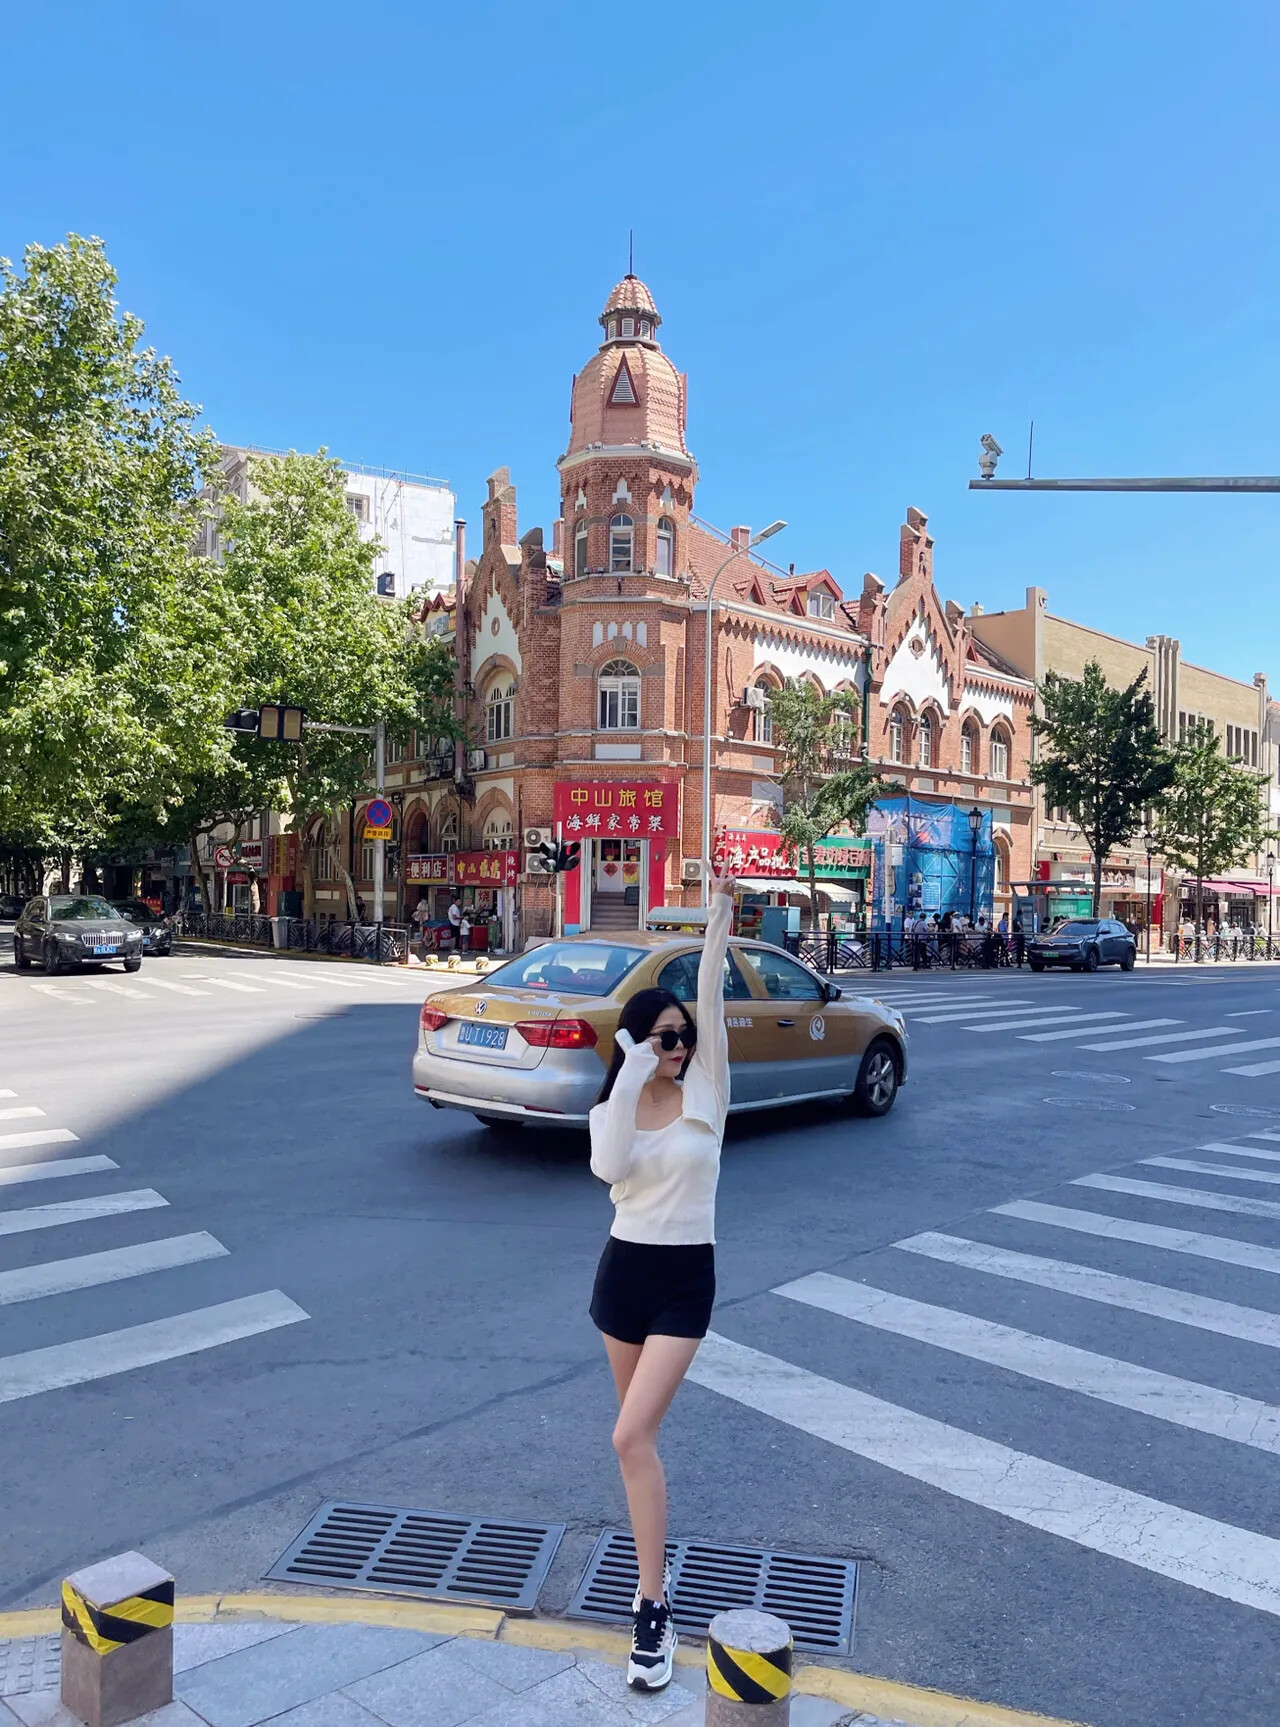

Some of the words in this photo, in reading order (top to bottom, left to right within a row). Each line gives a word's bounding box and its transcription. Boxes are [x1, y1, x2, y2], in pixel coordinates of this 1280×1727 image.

[571, 788, 663, 808] 中山旅馆
[566, 814, 664, 832] 海鲜家常菜
[410, 860, 442, 878] 便利店
